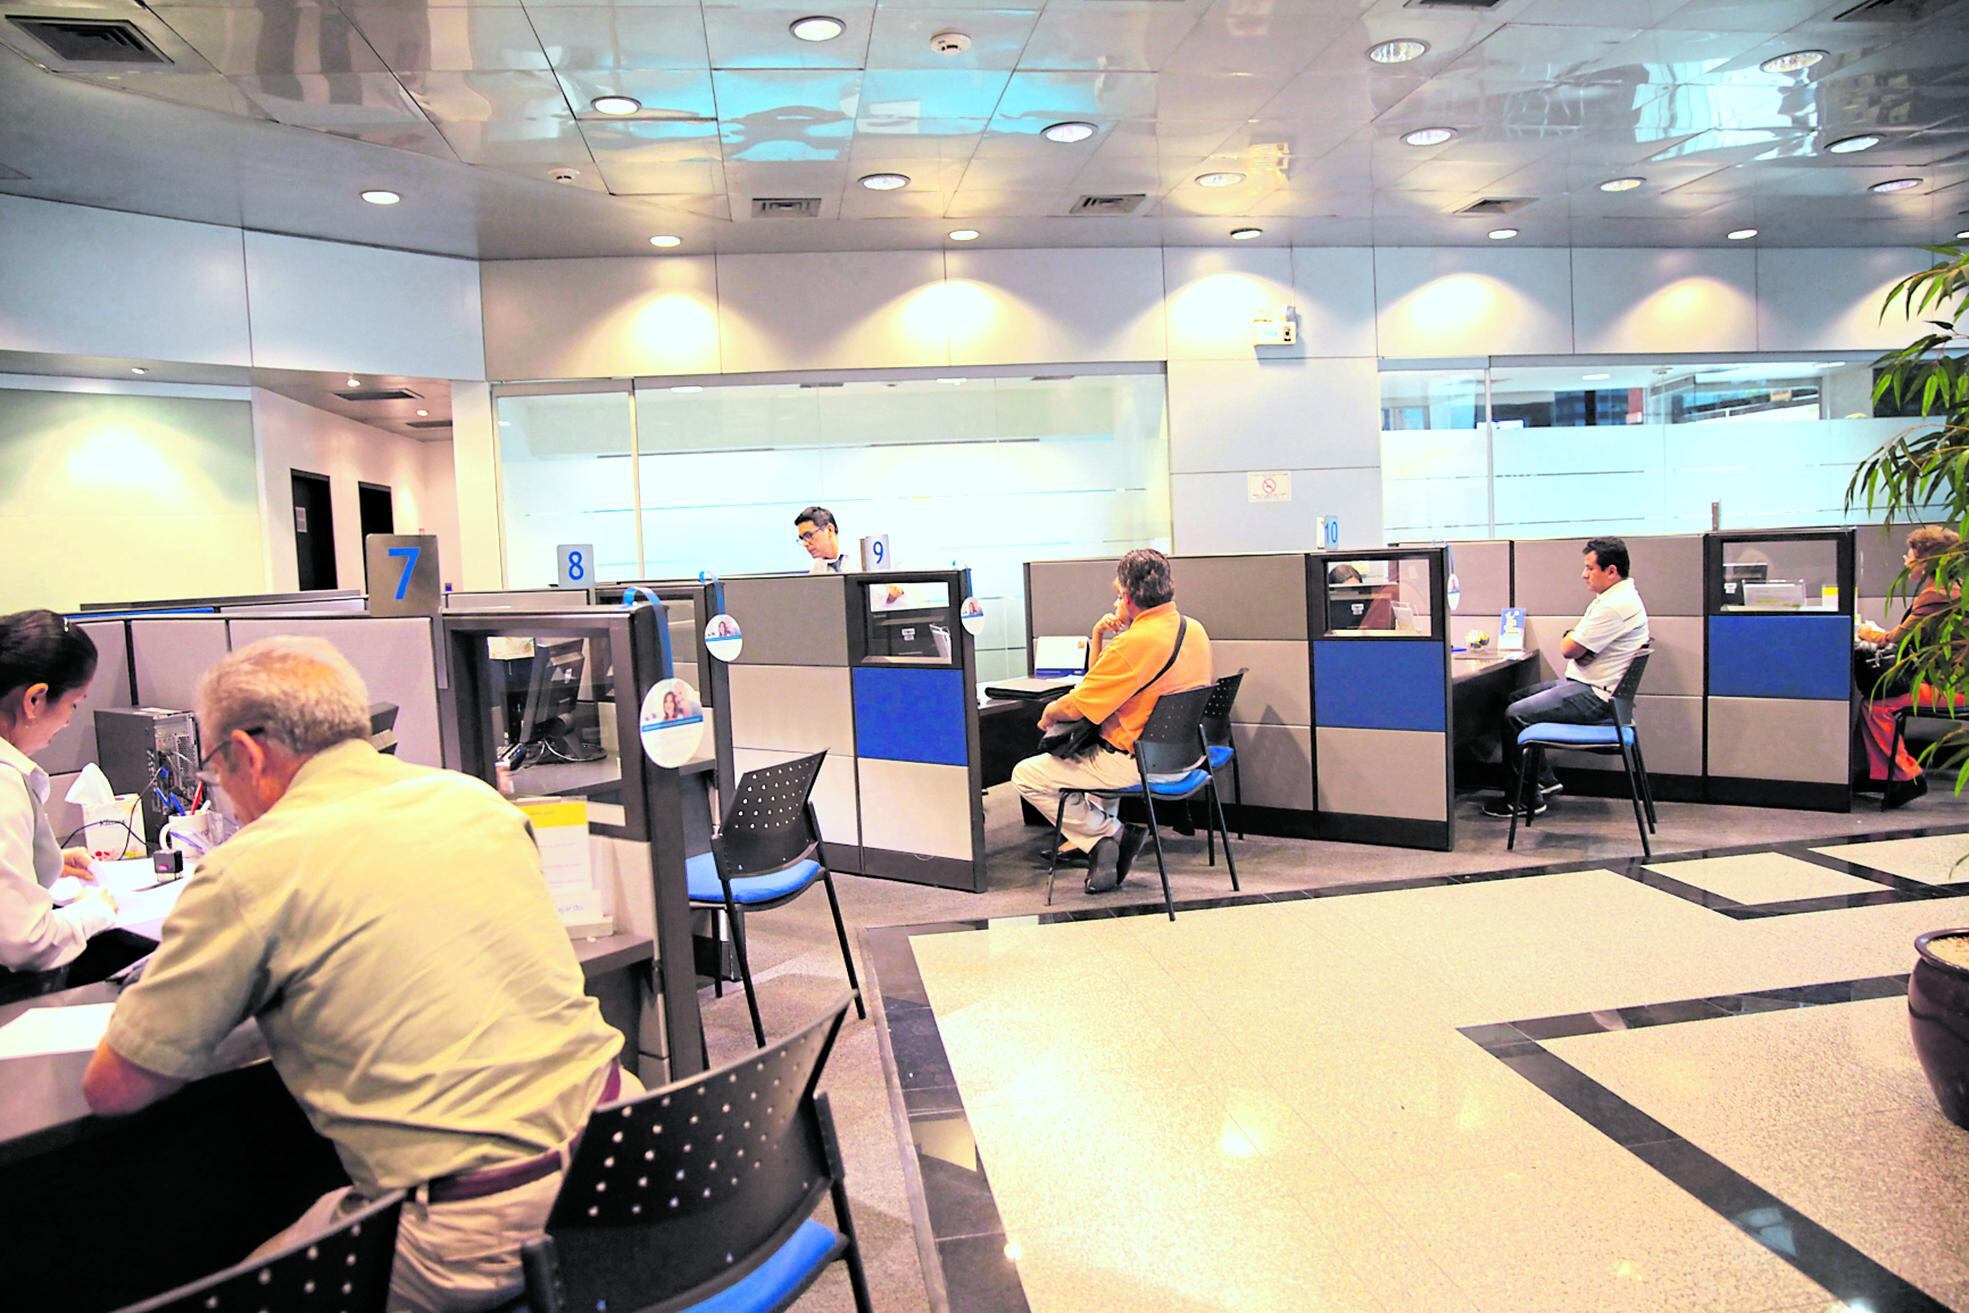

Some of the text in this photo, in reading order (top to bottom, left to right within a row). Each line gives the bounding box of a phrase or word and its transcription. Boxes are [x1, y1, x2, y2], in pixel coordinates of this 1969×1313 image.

[1325, 520, 1338, 544] 10
[568, 551, 584, 580] 8
[873, 541, 883, 564] 9
[388, 547, 420, 600] 7
